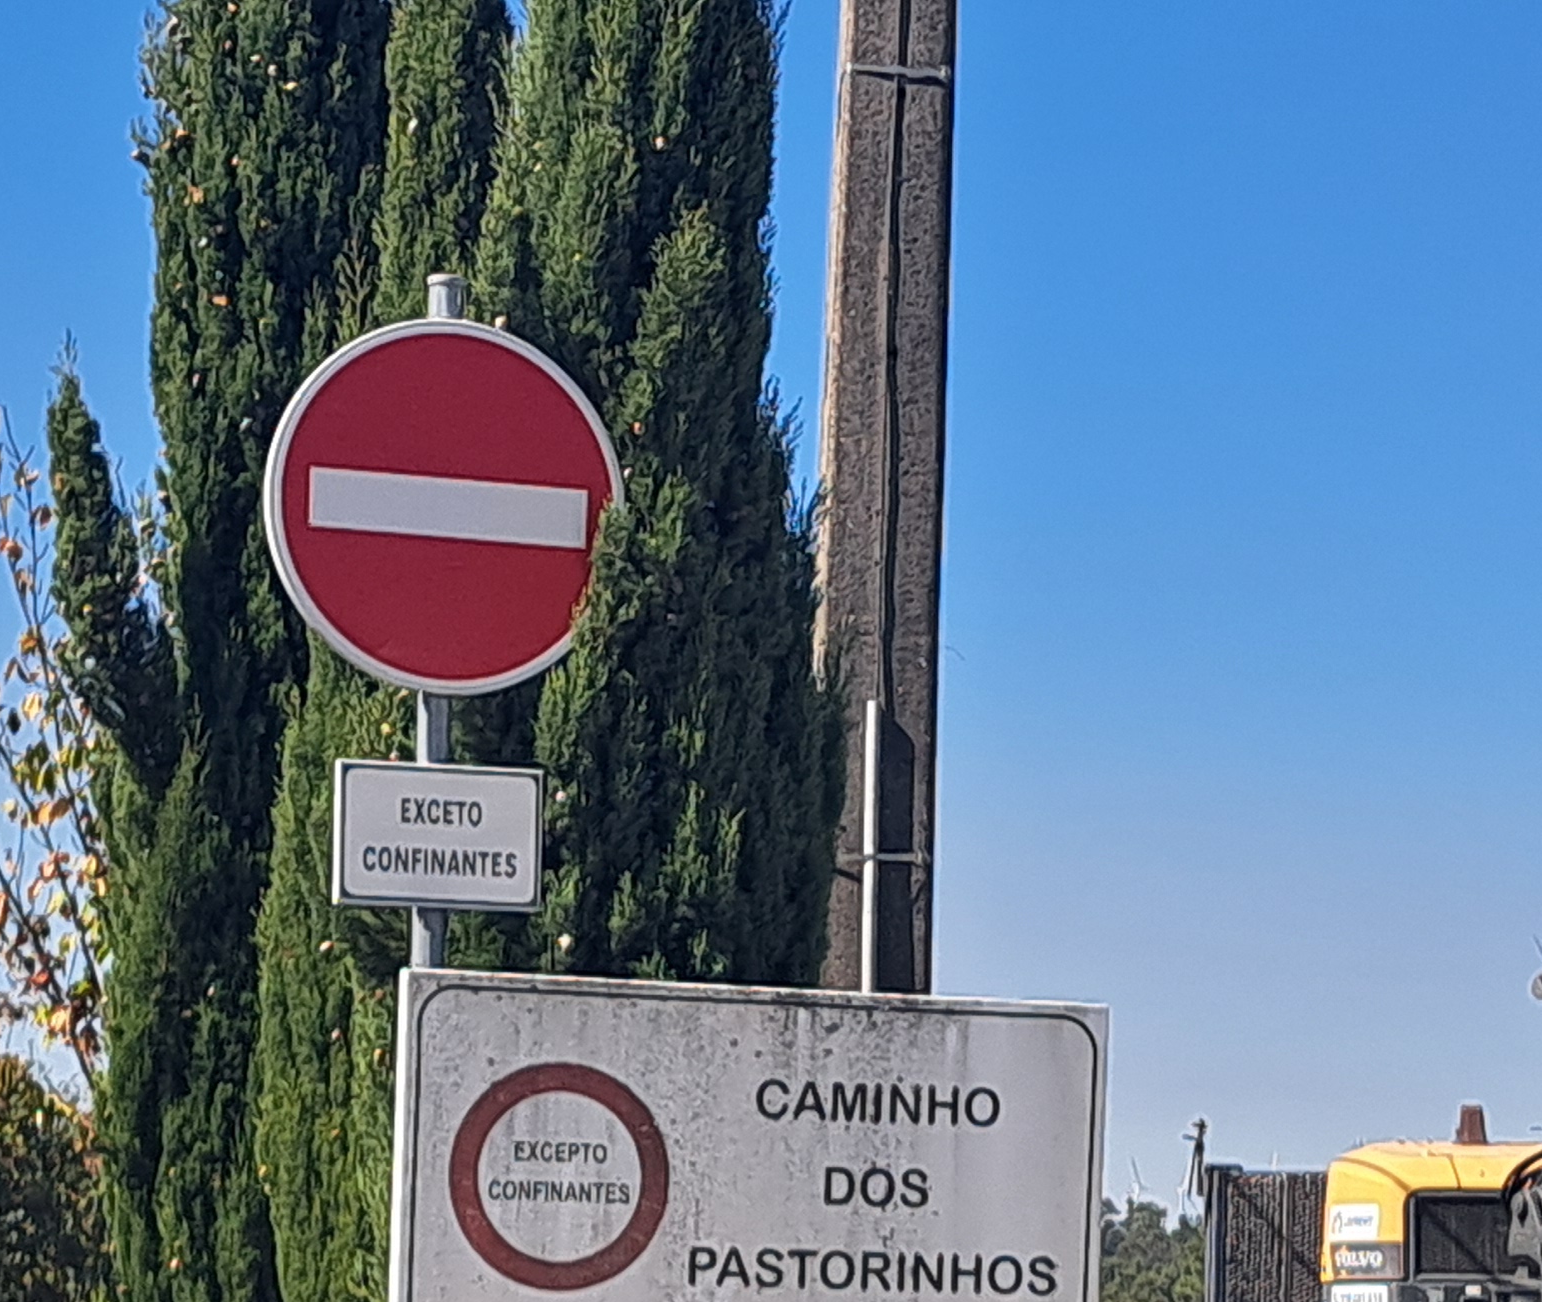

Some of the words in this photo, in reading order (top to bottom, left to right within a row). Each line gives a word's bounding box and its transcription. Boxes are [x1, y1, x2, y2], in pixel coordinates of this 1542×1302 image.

[400, 797, 482, 828] EXCETO
[362, 845, 517, 878] CONFINANTES
[758, 1078, 1001, 1127] CAMINHO
[513, 1140, 608, 1164] EXCEPTO
[488, 1179, 630, 1204] CONFINANTES
[823, 1166, 930, 1208] DOS
[688, 1246, 1058, 1296] PASTORINHOS
